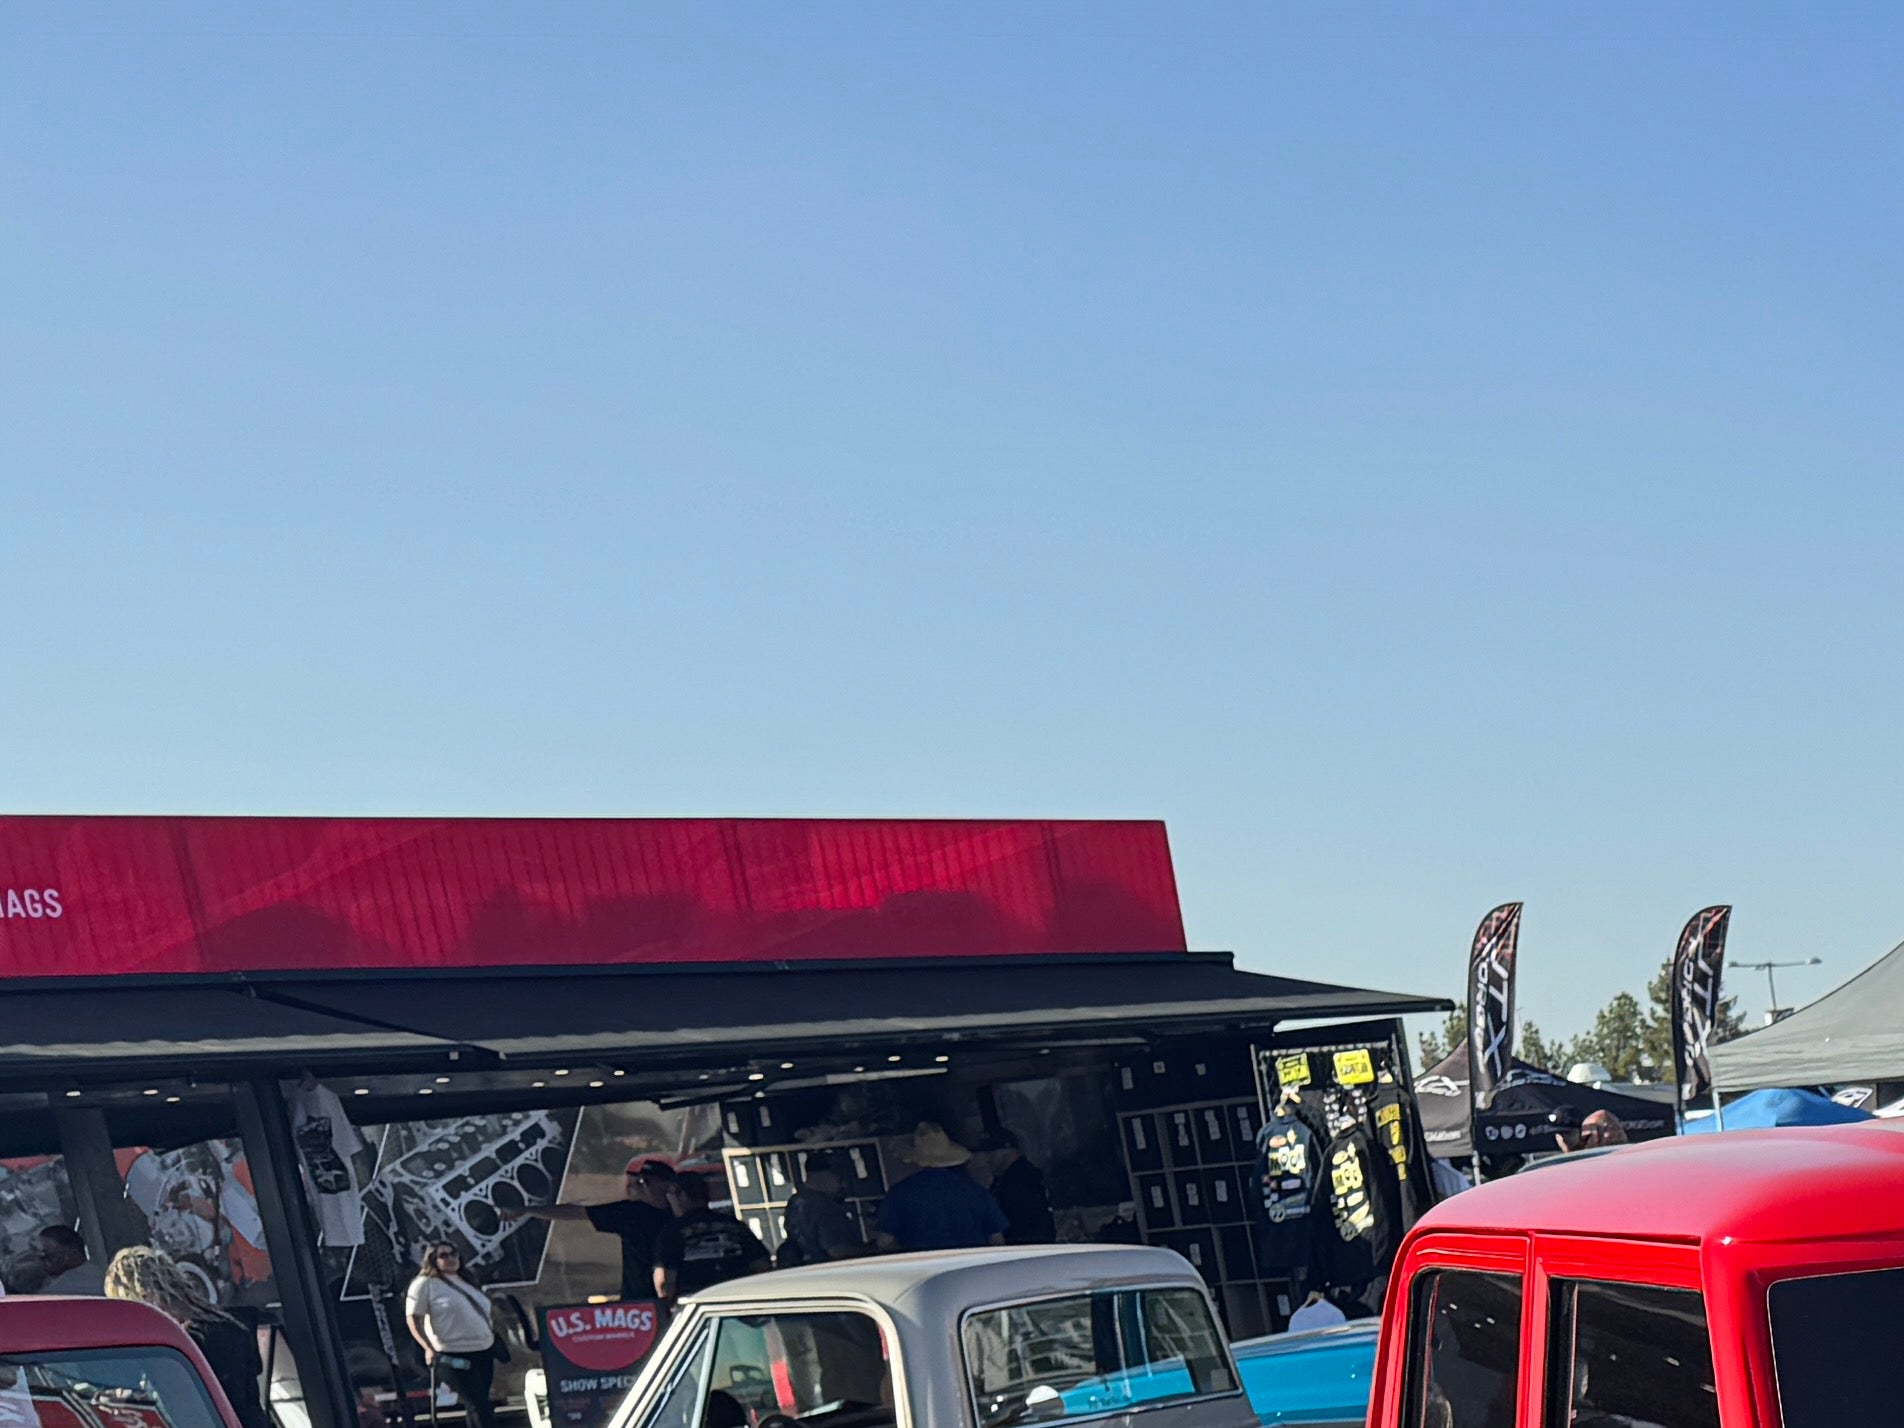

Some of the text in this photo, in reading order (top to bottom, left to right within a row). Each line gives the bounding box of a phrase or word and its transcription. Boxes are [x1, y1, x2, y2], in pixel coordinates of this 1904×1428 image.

[0, 888, 63, 918] AGS
[551, 1308, 652, 1338] U.S. MAGS
[560, 1374, 637, 1393] SHOW SPEC
